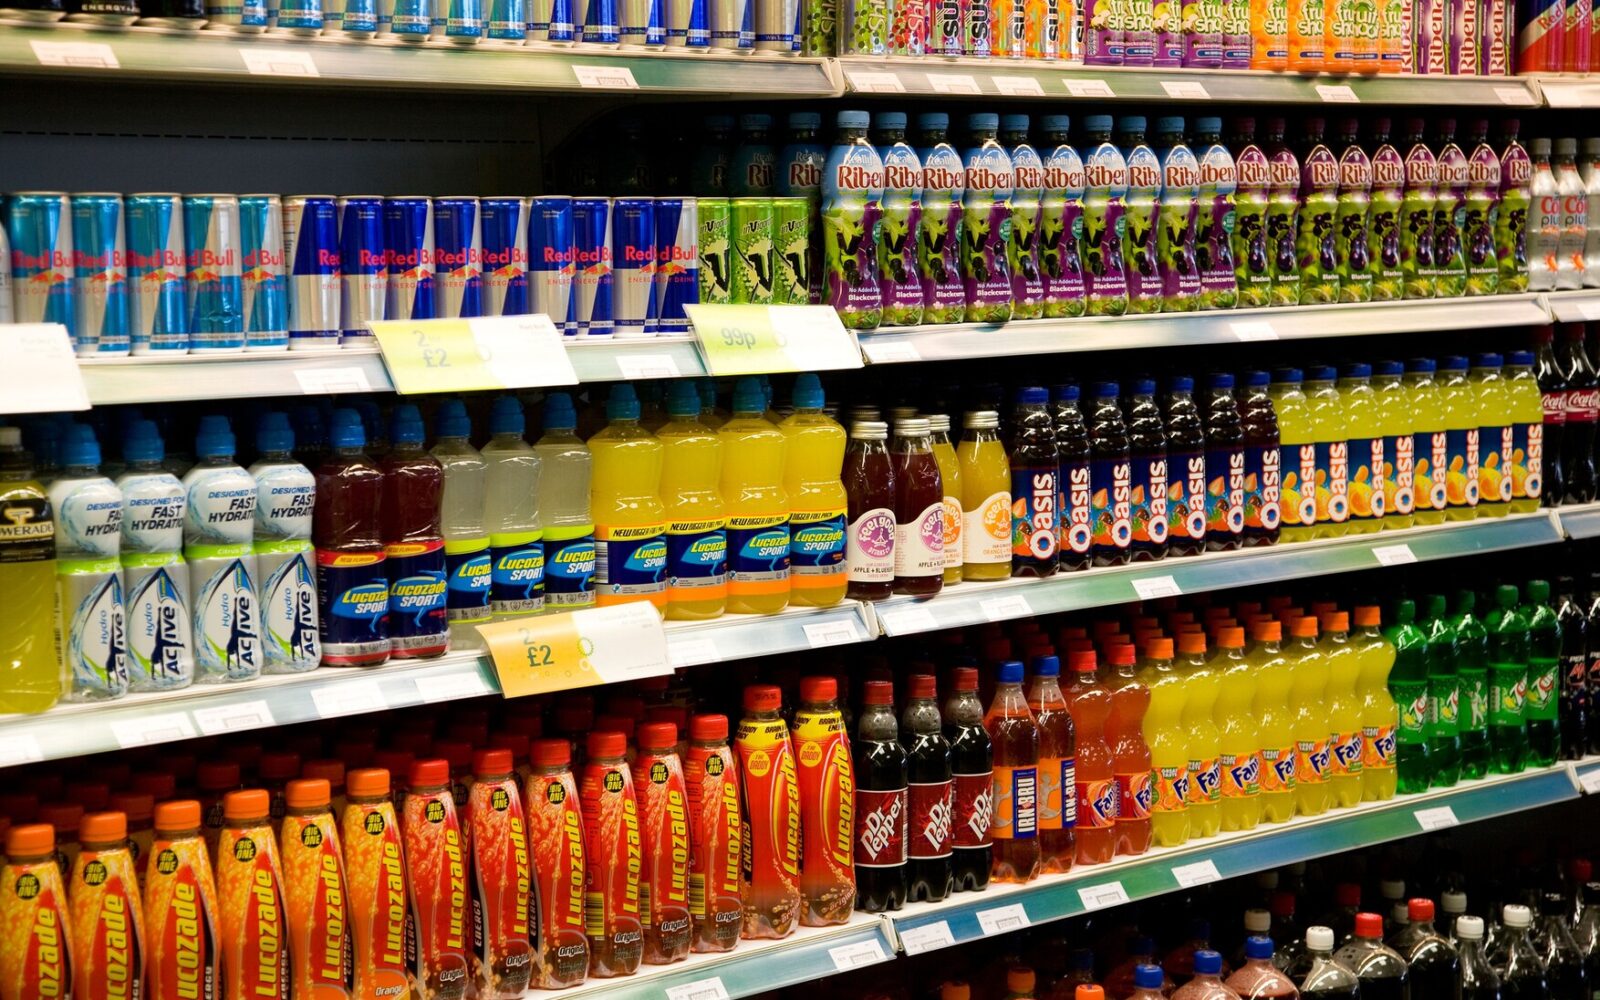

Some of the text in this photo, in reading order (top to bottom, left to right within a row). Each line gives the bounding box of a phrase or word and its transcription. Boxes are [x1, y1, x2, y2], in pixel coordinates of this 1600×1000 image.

[1015, 167, 1042, 188] Rib
[1166, 166, 1200, 187] Ribe
[201, 248, 235, 267] Bull
[720, 327, 756, 350] 99p
[423, 350, 451, 369] £2
[1525, 423, 1542, 498] Oasis
[1328, 442, 1348, 521] Oasis
[1394, 435, 1413, 514] Oasis
[1186, 456, 1206, 540] Oasis
[1261, 449, 1280, 530] Oasis
[87, 501, 121, 512] DESIGNE
[1069, 467, 1091, 553] Oasis
[1111, 463, 1131, 548] Oasis
[1147, 460, 1168, 544] Oasis
[151, 505, 183, 519] FAST
[1029, 472, 1056, 559] Oasis
[670, 522, 688, 531] NEW
[730, 517, 747, 526] NEW
[613, 528, 631, 537] NEW
[634, 546, 667, 560] Lucoza
[758, 545, 786, 558] SPORT
[803, 540, 833, 553] SPORT
[498, 556, 544, 570] Lucoza
[554, 549, 595, 563] Lucoza
[341, 586, 390, 604] Lucoza
[390, 581, 446, 598] Lucozade
[400, 596, 438, 607] SPORT
[526, 644, 556, 668] £2
[607, 772, 620, 782] BIG
[607, 781, 623, 790] ONE
[493, 790, 506, 801] BIG
[549, 783, 562, 793] BIG
[549, 792, 564, 802] ONE
[427, 801, 441, 812] BIG
[493, 800, 508, 810] ONE
[928, 797, 947, 826] Dr
[368, 813, 382, 824] BIG
[427, 810, 443, 821] ONE
[865, 806, 886, 835] Dr
[303, 825, 318, 836] BIG
[367, 822, 384, 833] ONE
[860, 794, 903, 861] Pepper
[236, 839, 252, 849] BIG
[303, 835, 320, 846] ONE
[666, 790, 688, 902] Lucozade
[723, 781, 741, 893] Lucozade
[236, 848, 254, 860] ONE
[623, 799, 641, 913] Lucozade
[510, 817, 529, 935] Lucozade
[565, 810, 584, 927] Lucozade
[445, 829, 465, 949] Lucozade
[383, 842, 405, 965] Lucozade
[320, 854, 343, 980] Lucozade
[253, 869, 278, 997] Lucozade
[101, 893, 128, 1000] cozade
[558, 944, 584, 957] Original
